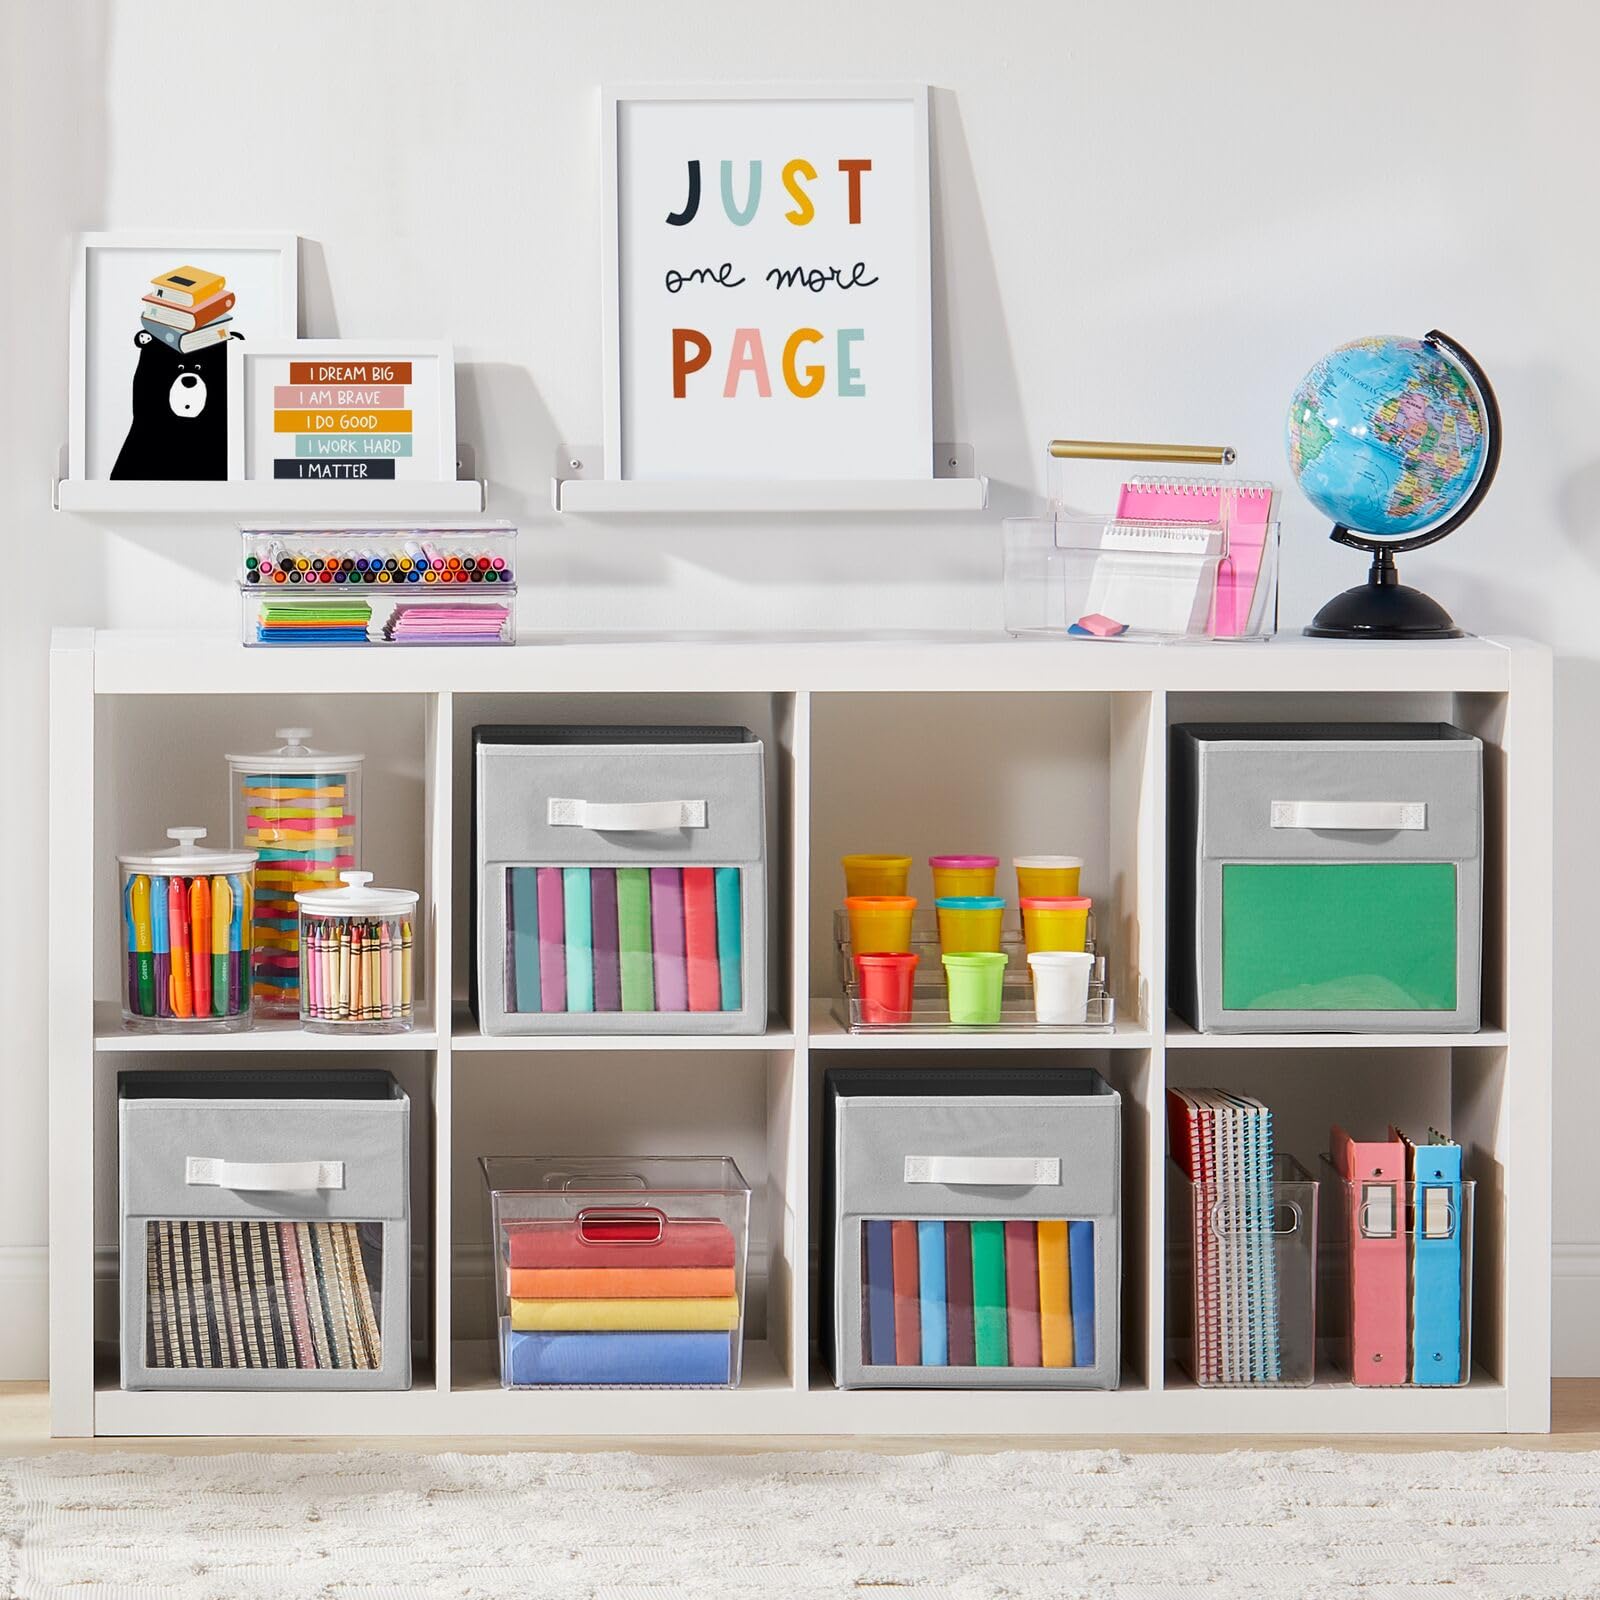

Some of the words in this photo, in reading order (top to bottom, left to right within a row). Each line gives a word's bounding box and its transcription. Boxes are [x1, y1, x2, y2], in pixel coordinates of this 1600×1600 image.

[665, 158, 873, 227] JUST
[665, 262, 746, 294] one
[765, 261, 879, 293] more
[672, 326, 867, 399] PAGE
[309, 367, 314, 381] I
[319, 366, 367, 382] DREAM
[372, 366, 395, 382] BIG
[300, 391, 304, 405] I
[309, 390, 333, 406] AM
[337, 390, 381, 405] BRAVE
[307, 415, 311, 429] I
[315, 415, 335, 430] DO
[339, 414, 378, 430] GOOD
[308, 439, 313, 453] I
[318, 438, 359, 454] WORK
[363, 438, 401, 454] HARD
[299, 464, 304, 478] I
[308, 463, 369, 478] MATTER
